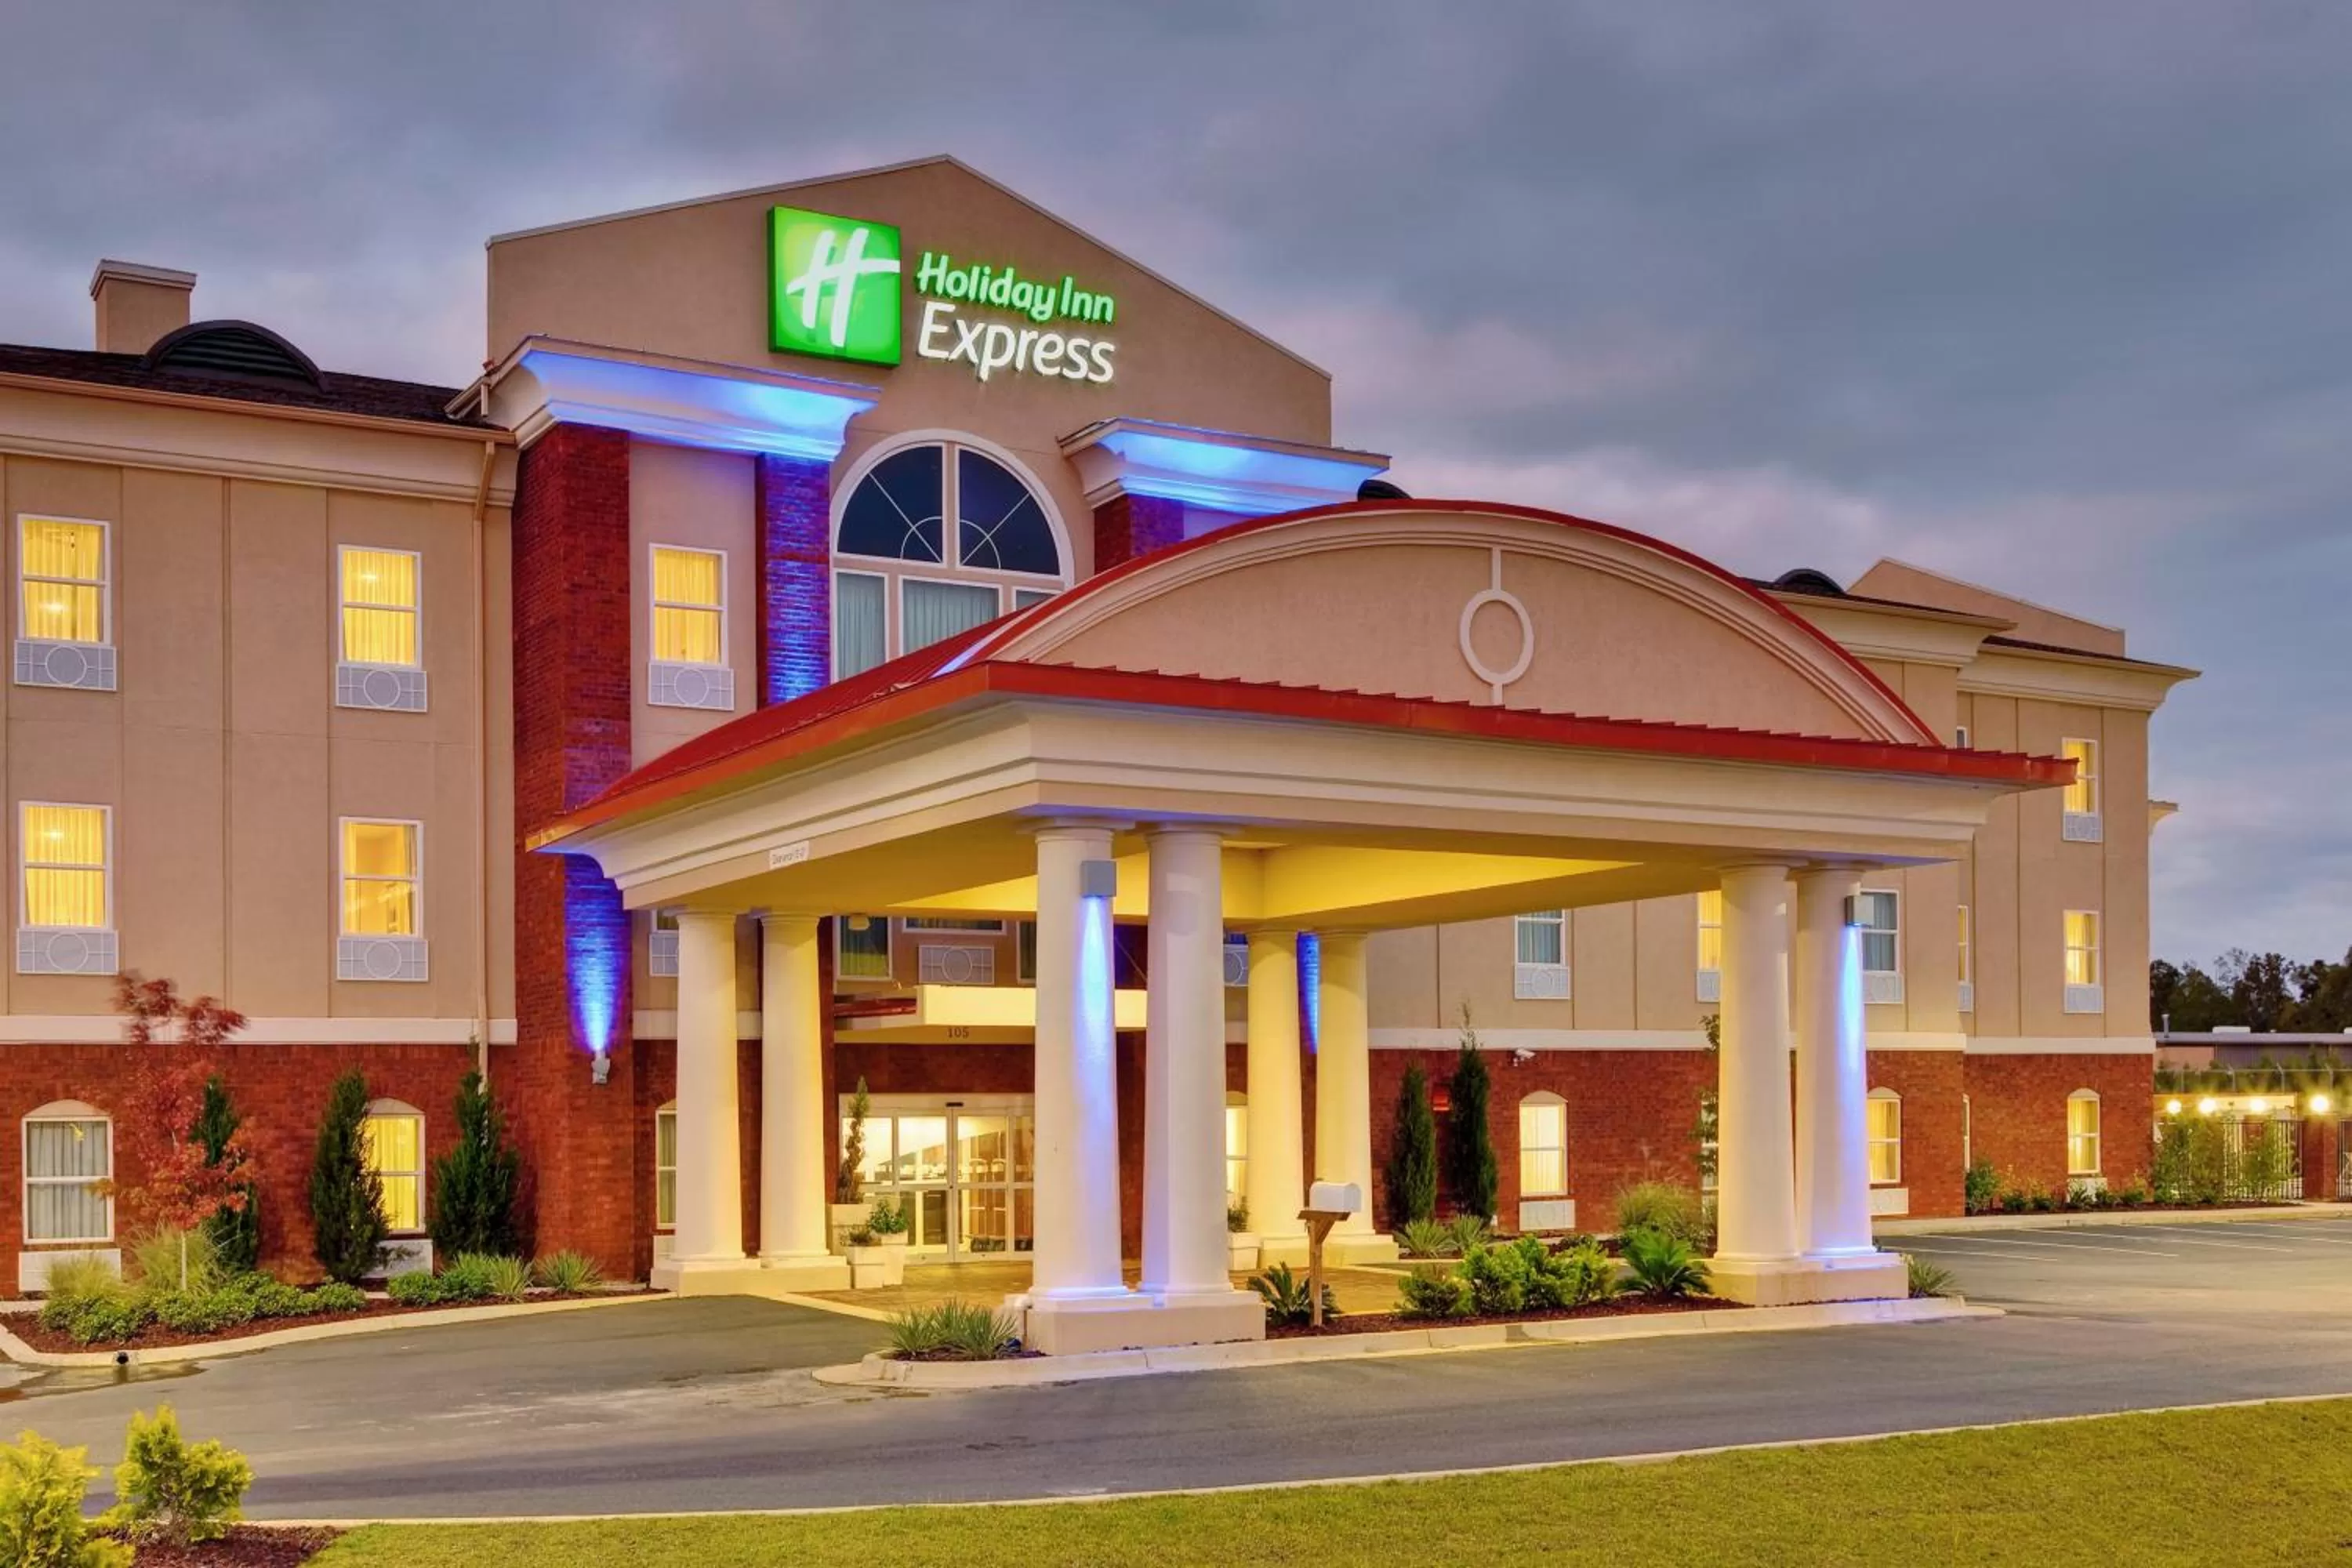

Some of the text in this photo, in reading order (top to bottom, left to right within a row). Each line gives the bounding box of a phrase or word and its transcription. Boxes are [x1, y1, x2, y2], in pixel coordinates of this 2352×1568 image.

[786, 227, 901, 347] H
[916, 252, 1114, 324] Holiday Inn
[917, 300, 1116, 383] Express
[947, 1026, 969, 1039] 105
